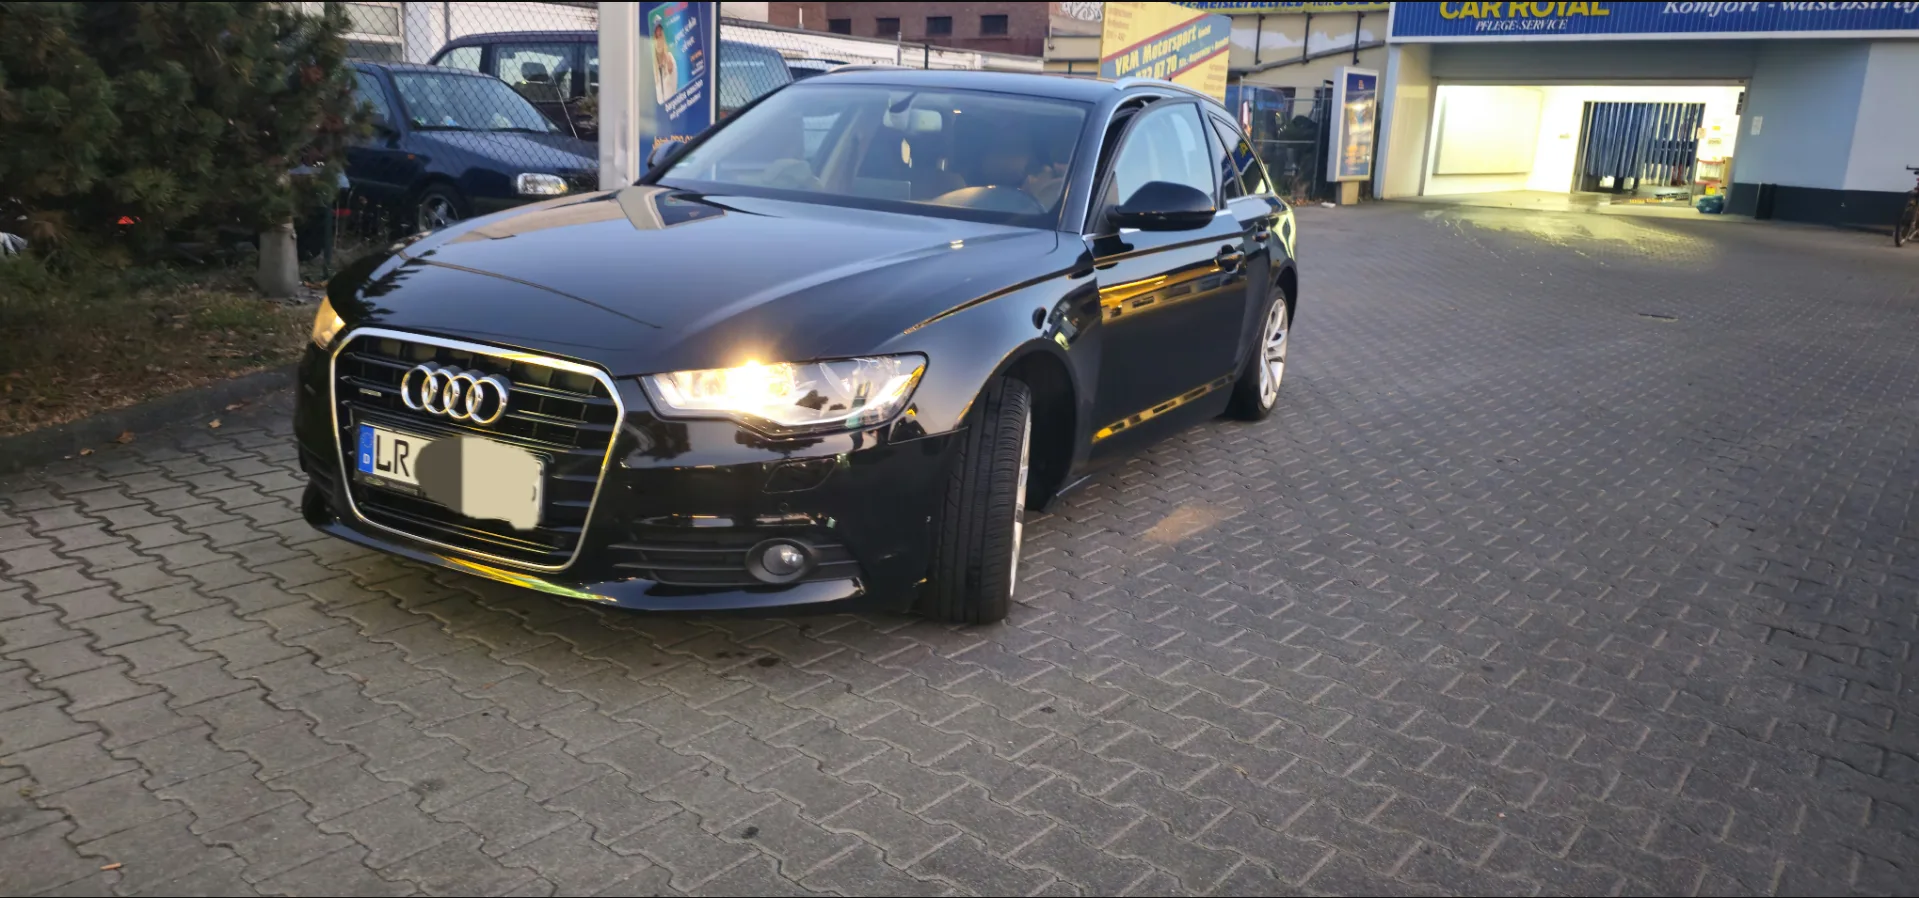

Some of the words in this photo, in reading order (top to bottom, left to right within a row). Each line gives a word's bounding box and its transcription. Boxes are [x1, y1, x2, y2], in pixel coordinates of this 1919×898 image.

[1439, 2, 1501, 19] CAR
[1508, 2, 1610, 18] ROYAL
[1115, 49, 1140, 77] VRM
[1143, 23, 1197, 65] Motorsport
[363, 453, 371, 464] D
[376, 434, 410, 477] LR
